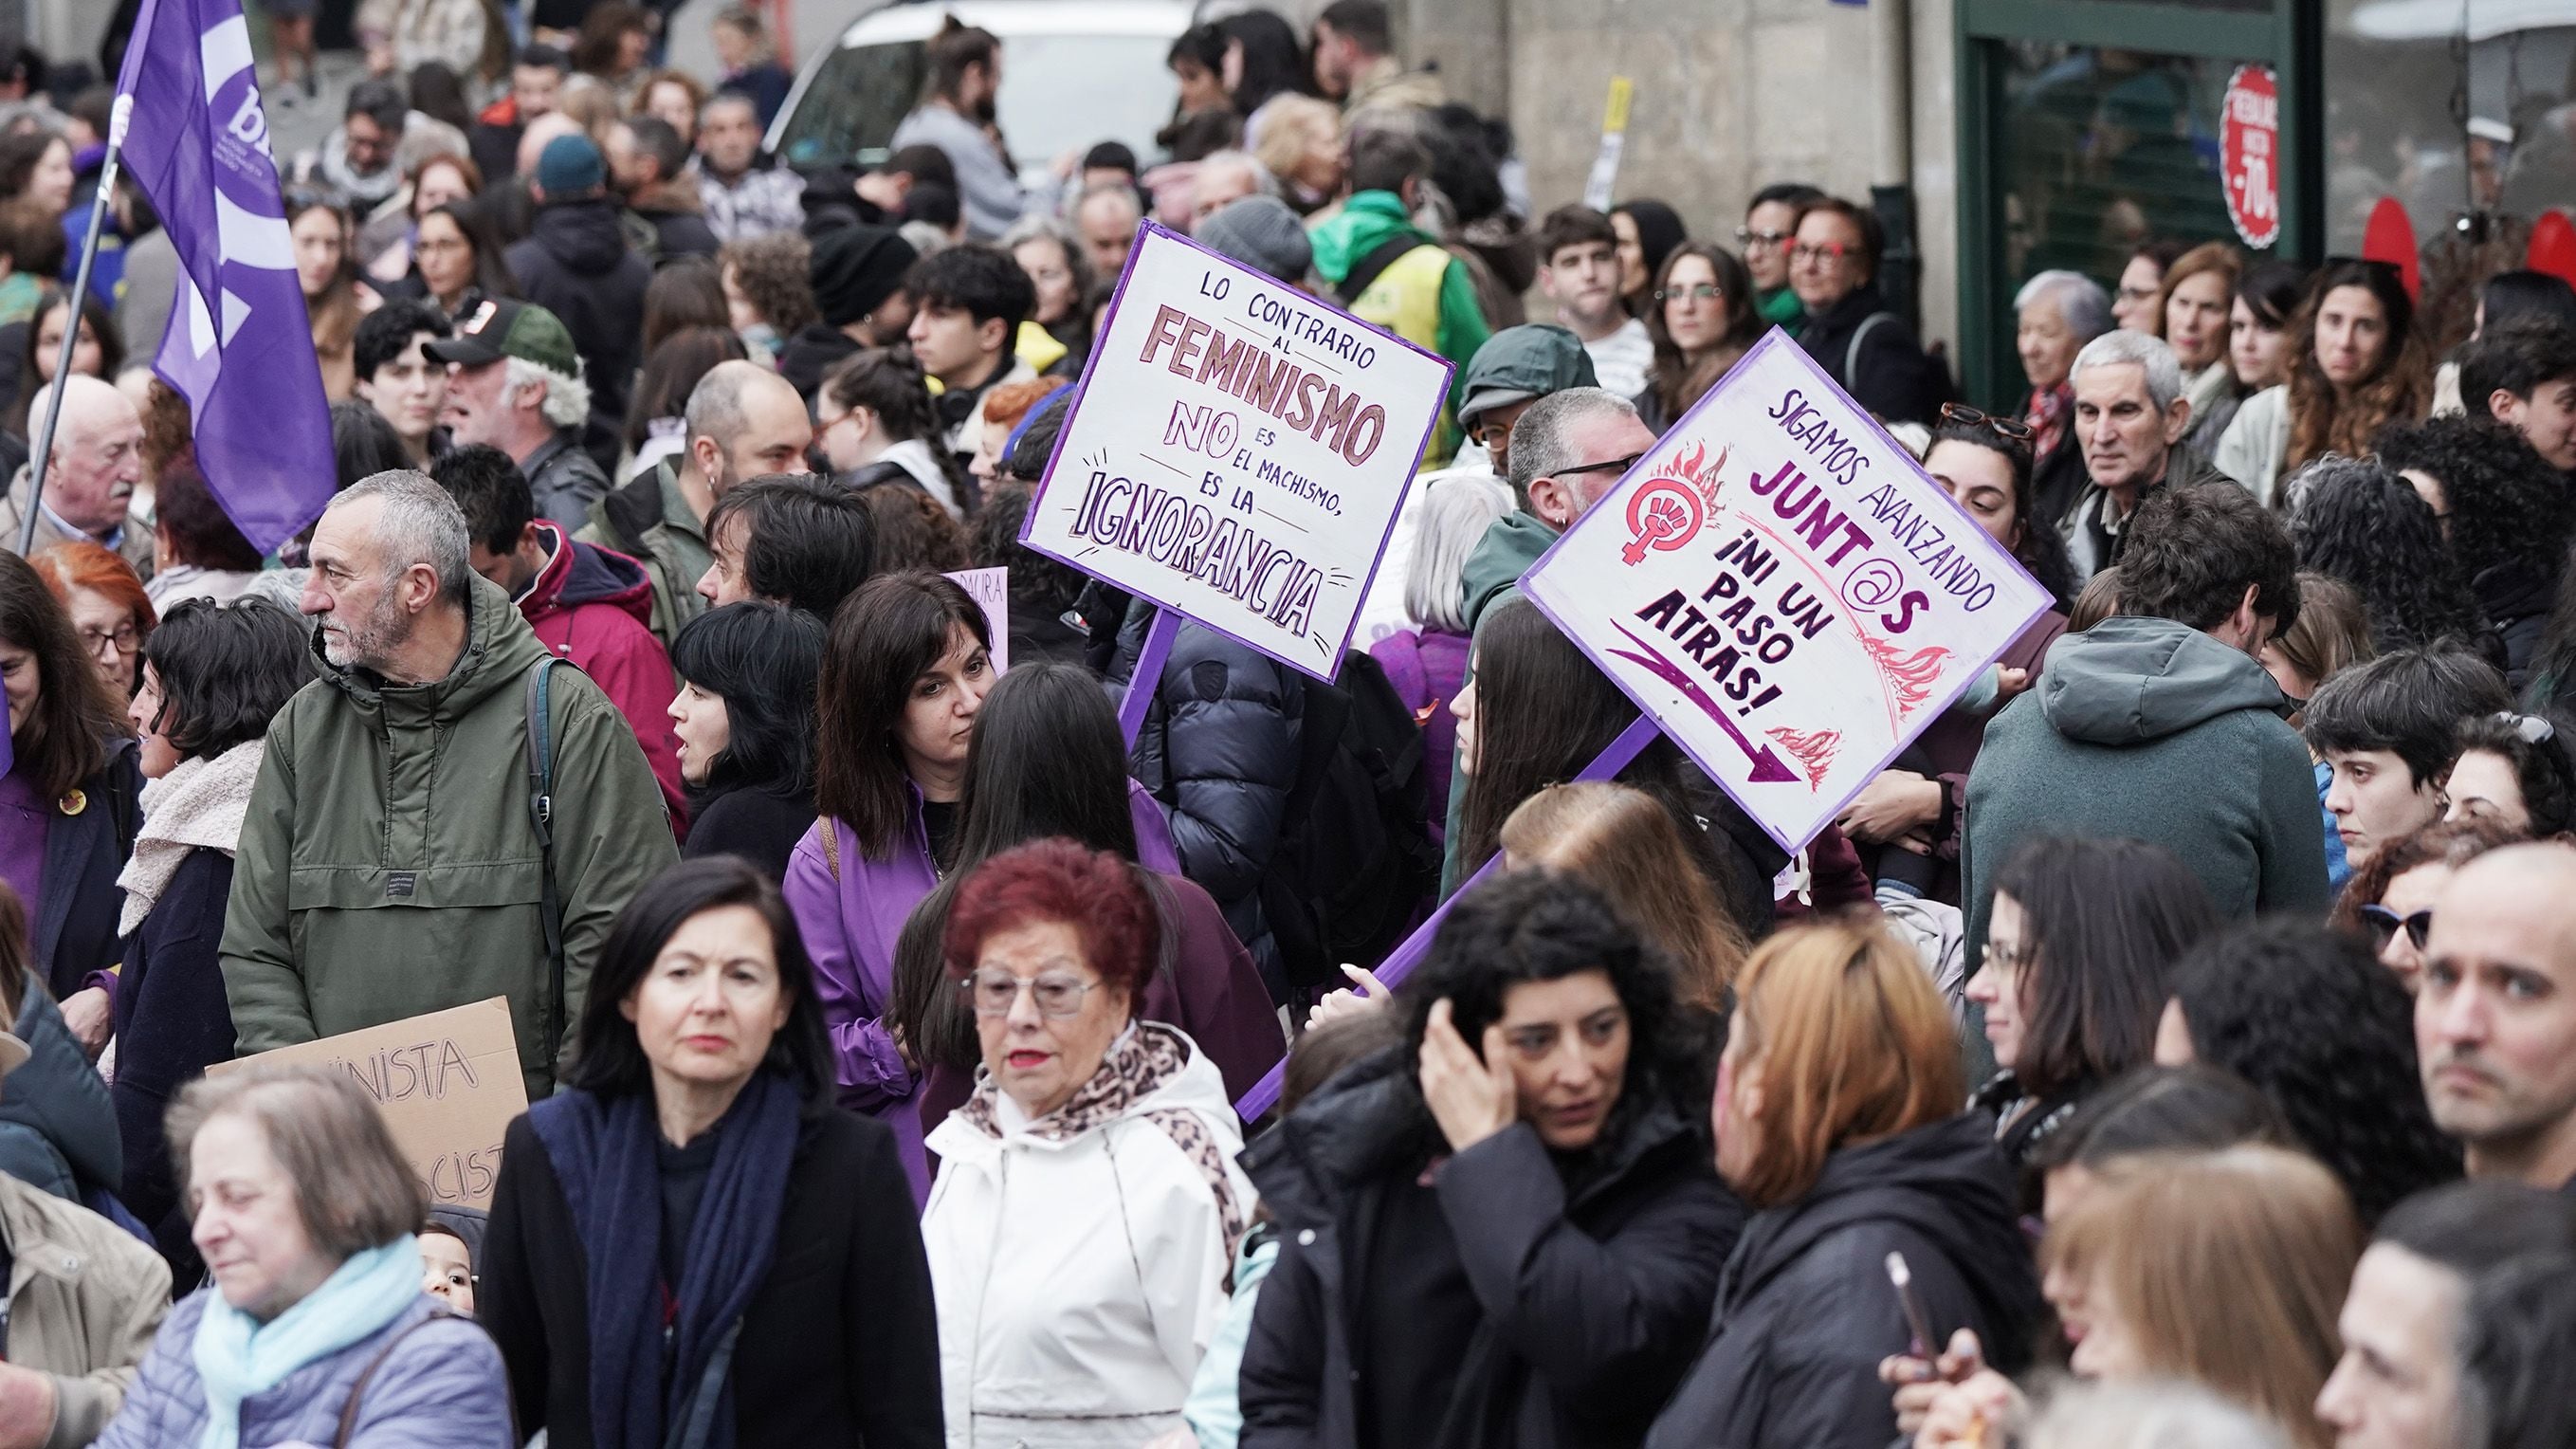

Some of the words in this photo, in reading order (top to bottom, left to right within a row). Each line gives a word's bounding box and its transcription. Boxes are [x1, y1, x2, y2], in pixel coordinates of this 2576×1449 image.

[1200, 271, 1231, 300] LO
[1248, 293, 1375, 369] CONTRARIO
[1272, 336, 1290, 355] AL
[1140, 303, 1385, 467] FEMINISMO
[1163, 400, 1238, 458] NO
[1254, 427, 1276, 447] ES
[1199, 471, 1223, 497] ES
[1231, 486, 1253, 514] LA
[1233, 449, 1252, 470] EL
[1256, 459, 1342, 516] MACHISMO,
[1768, 389, 1870, 485] SIGAMOS
[1858, 484, 1995, 612] AVANZANDO
[1069, 471, 1323, 638] IGNORANCIA
[1713, 528, 1780, 587] ¡NI
[1777, 581, 1835, 640] UN
[1750, 460, 1929, 633] JUNT@S
[1635, 589, 1782, 717] ATRÁS!
[1701, 571, 1794, 664] PASO
